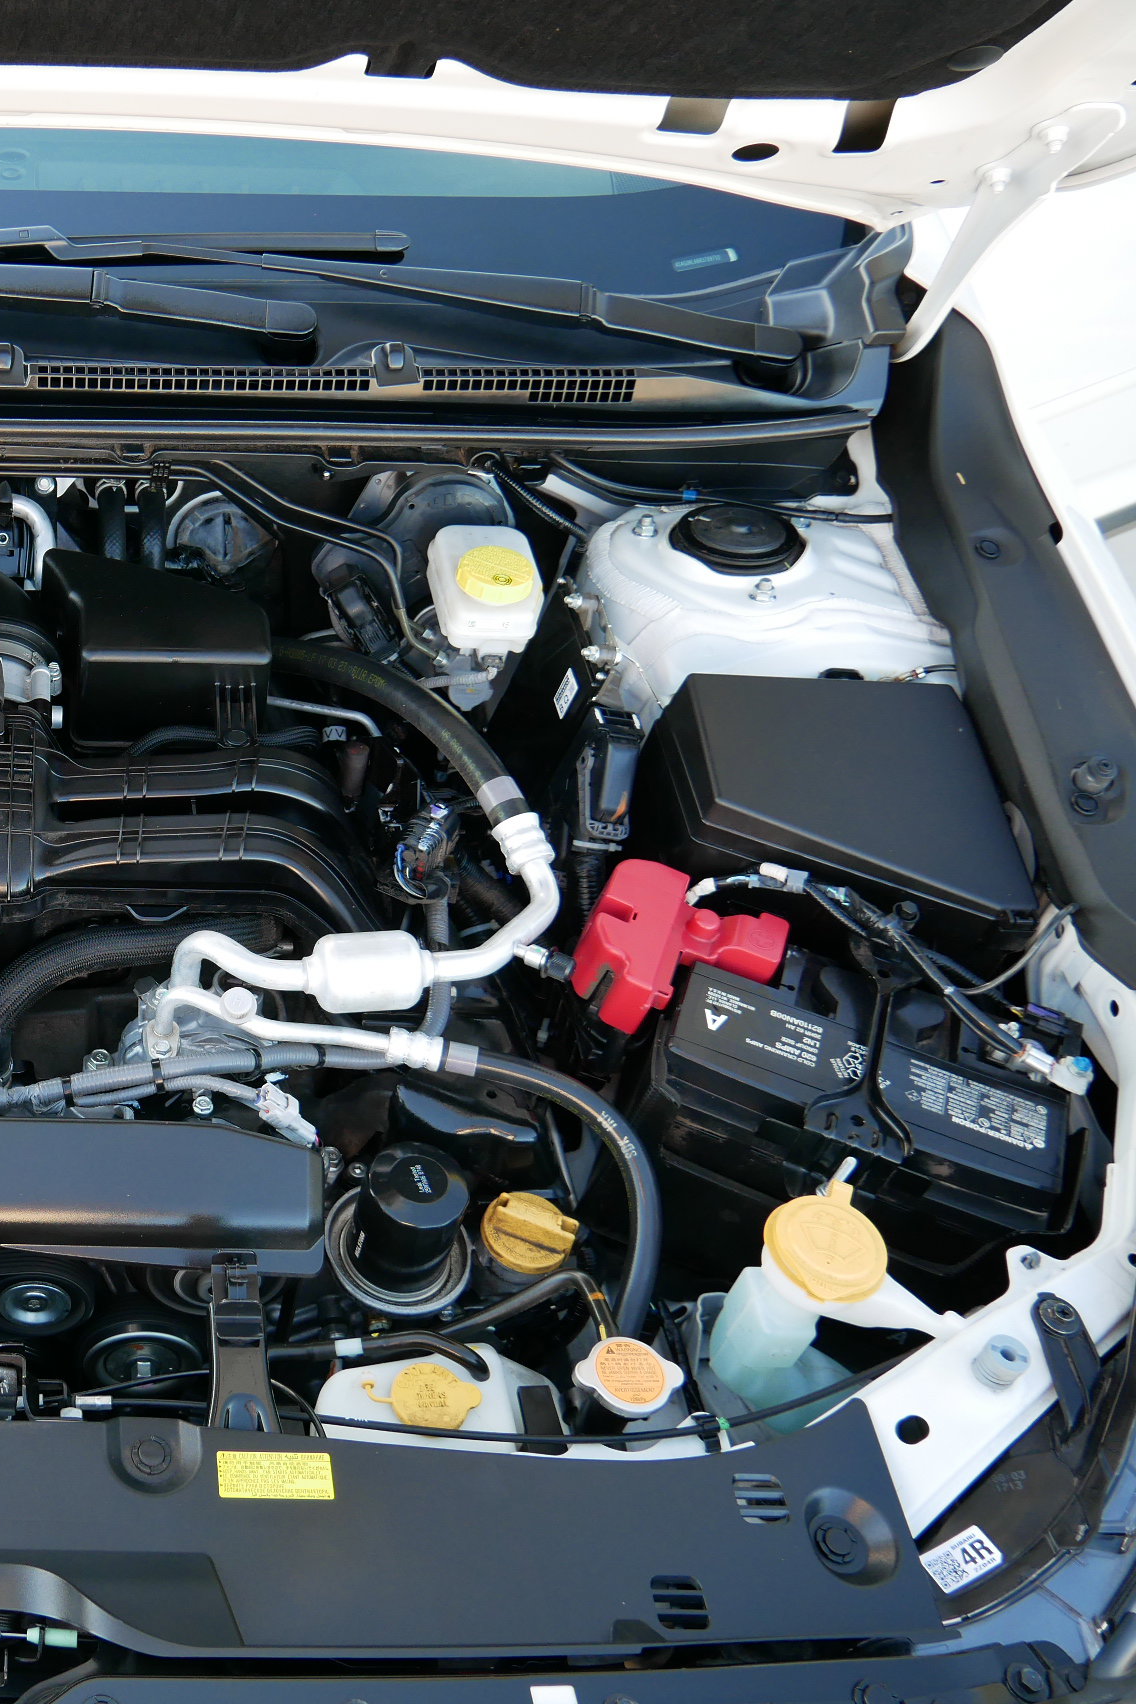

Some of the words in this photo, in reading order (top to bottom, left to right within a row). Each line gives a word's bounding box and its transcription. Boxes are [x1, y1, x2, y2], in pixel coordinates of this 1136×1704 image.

[744, 1037, 763, 1048] AMPS
[774, 1040, 801, 1055] AMPS
[762, 1044, 797, 1060] CRANKING
[796, 1056, 815, 1067] COLD
[950, 1533, 976, 1550] SUBARU
[960, 1538, 994, 1565] 4R
